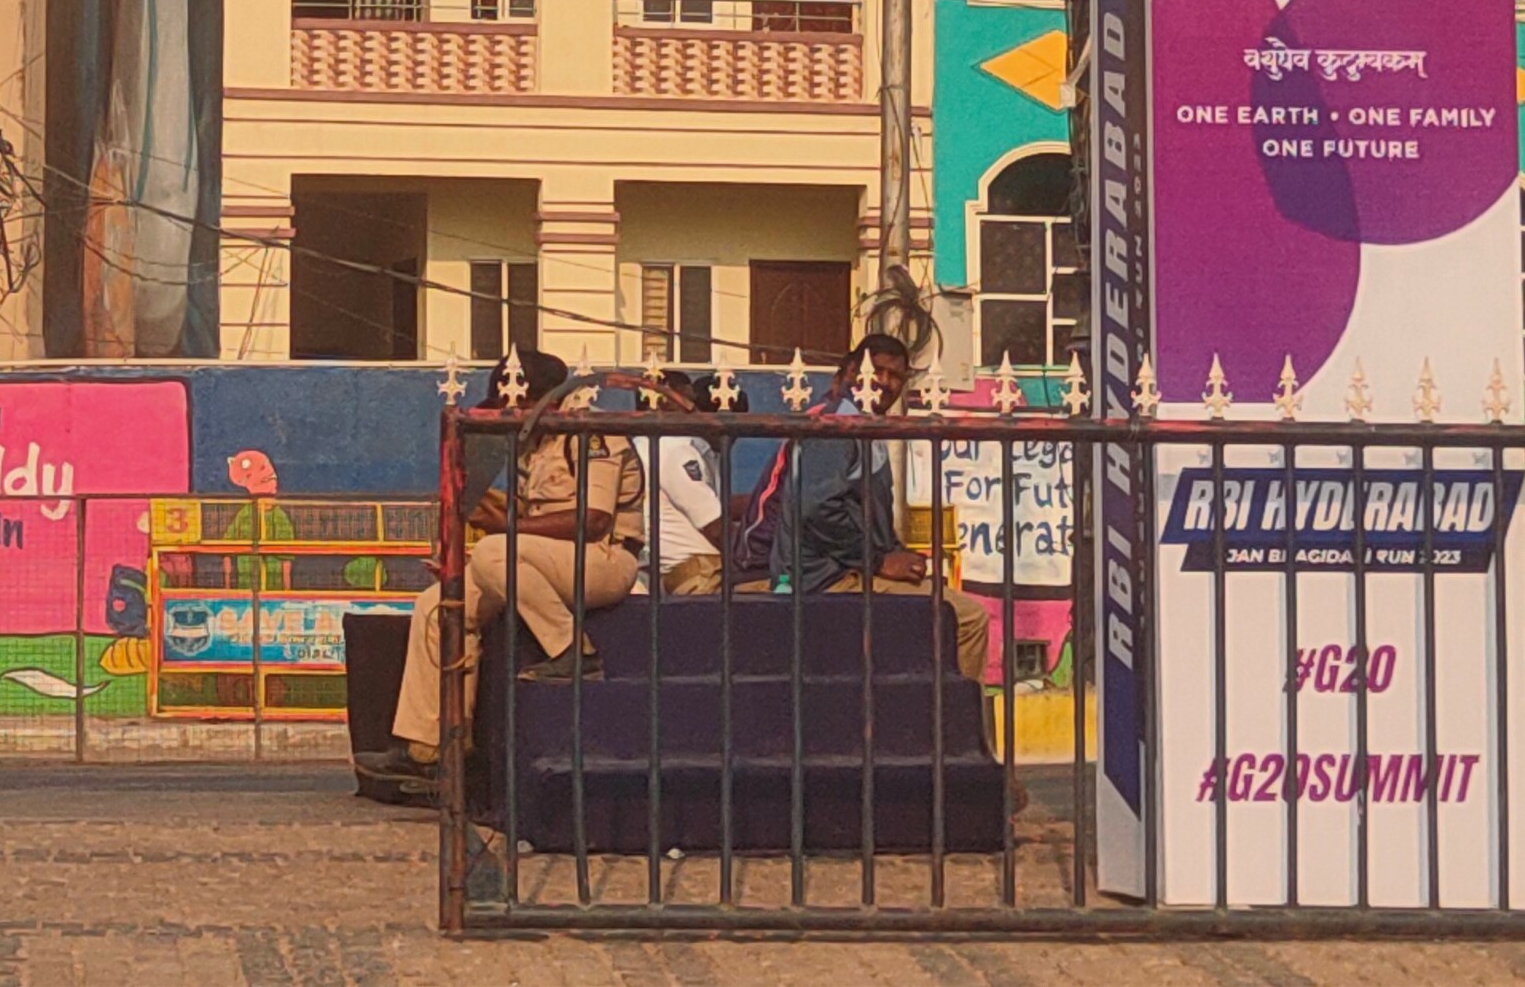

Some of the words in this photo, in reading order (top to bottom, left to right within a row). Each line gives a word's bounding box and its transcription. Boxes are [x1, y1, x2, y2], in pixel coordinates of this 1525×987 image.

[1176, 105, 1229, 124] ONE
[1237, 106, 1319, 125] EARTH
[1349, 107, 1401, 126] ONE
[1409, 107, 1497, 128] FAMILY
[1262, 139, 1314, 158] ONE
[1323, 140, 1420, 160] FUTURE
[944, 469, 1001, 504] For
[1013, 472, 1074, 509] Fut
[1227, 548, 1265, 563] JAN
[1375, 549, 1416, 565] RUN
[1107, 525, 1134, 671] RBI
